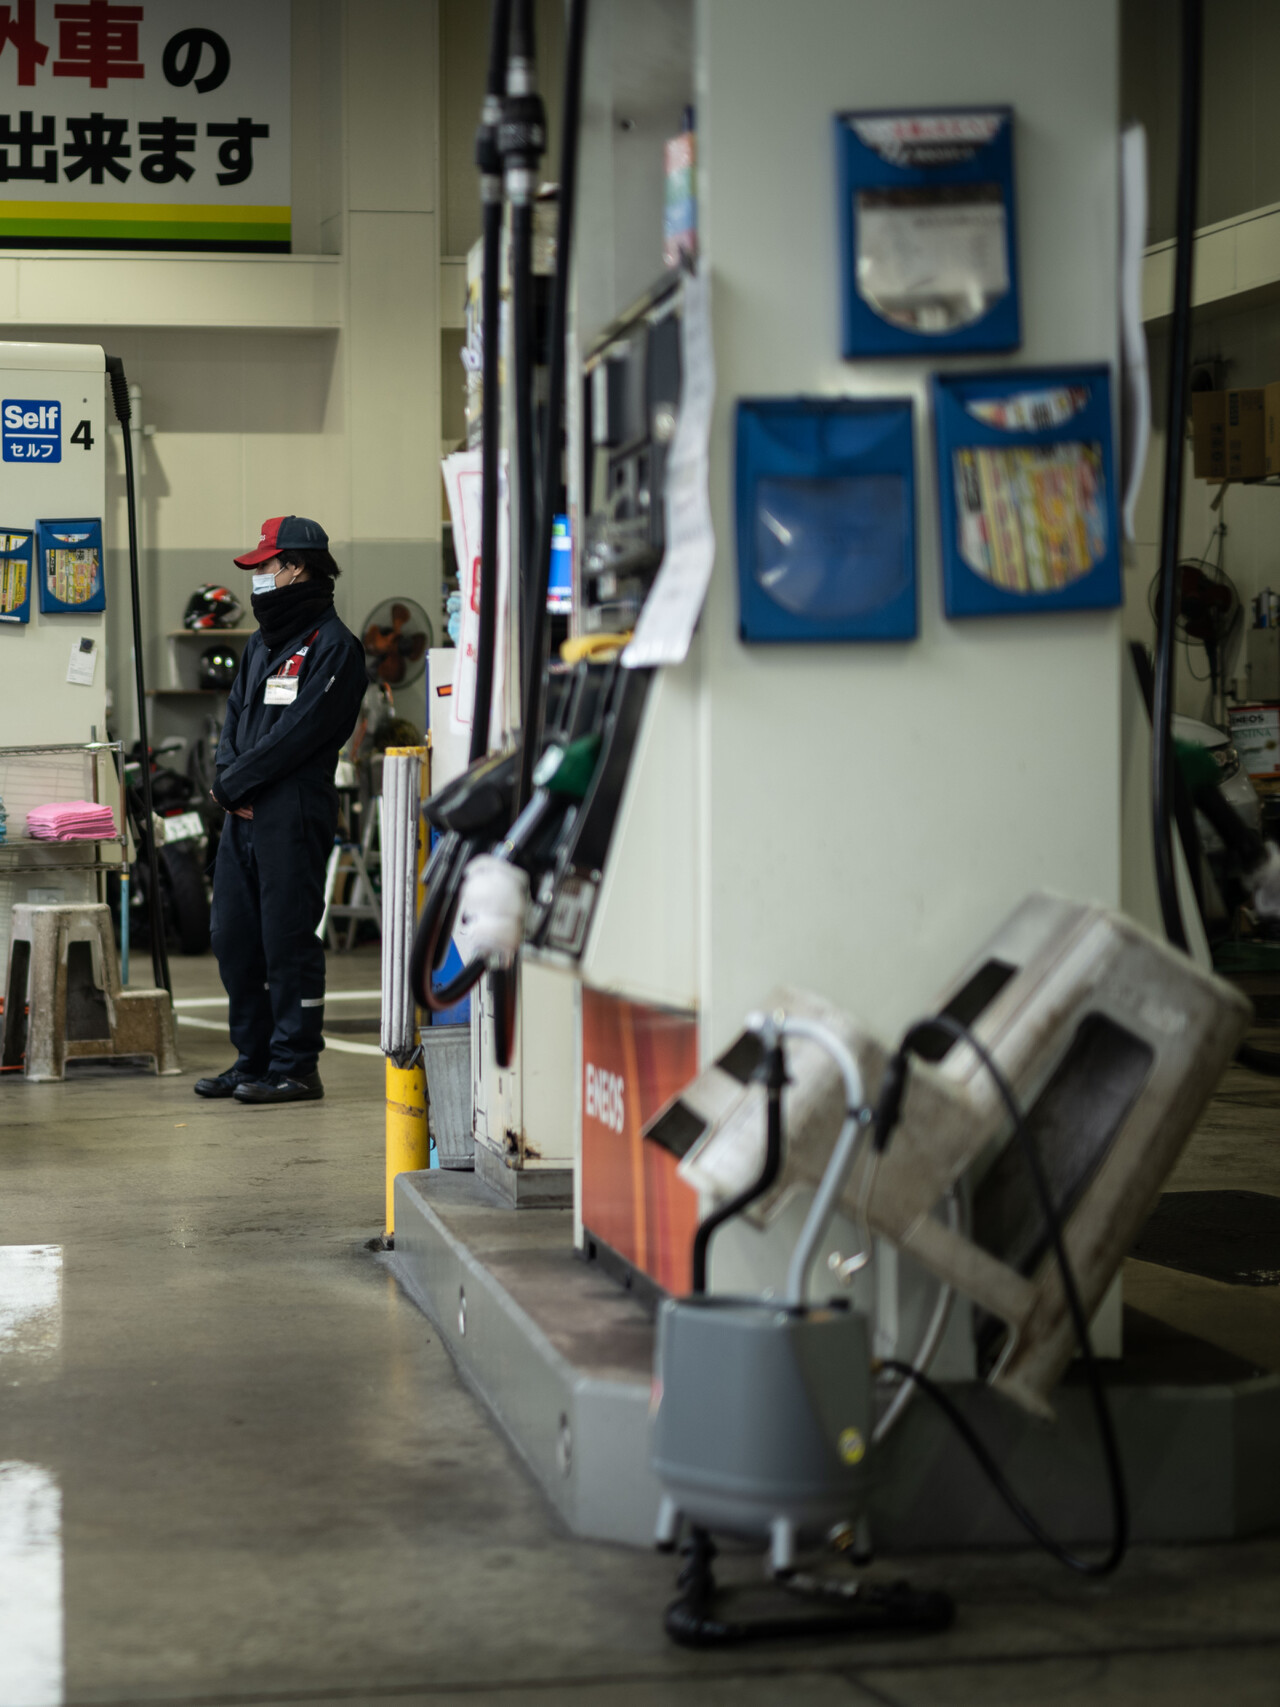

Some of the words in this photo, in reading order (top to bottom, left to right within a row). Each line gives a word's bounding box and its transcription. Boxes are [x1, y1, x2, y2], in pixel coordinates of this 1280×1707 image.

[4, 406, 59, 430] Self
[70, 420, 95, 450] 4
[10, 443, 54, 458] セルフ
[586, 1062, 625, 1135] ENEOS
